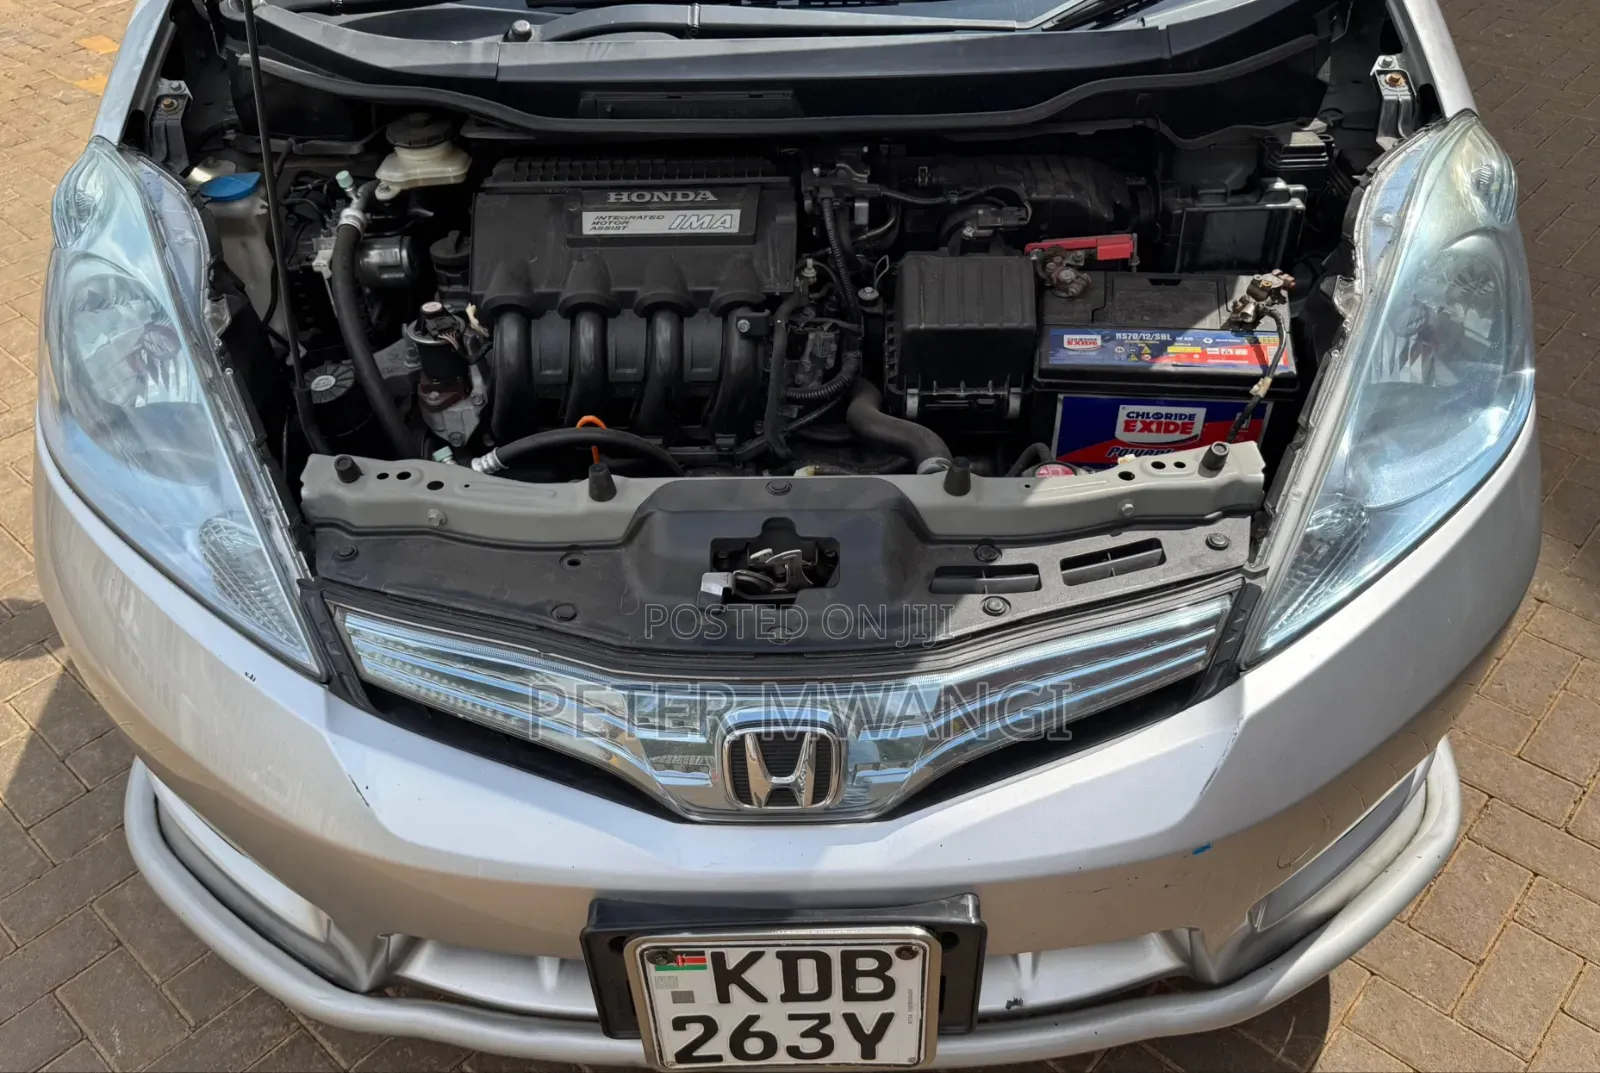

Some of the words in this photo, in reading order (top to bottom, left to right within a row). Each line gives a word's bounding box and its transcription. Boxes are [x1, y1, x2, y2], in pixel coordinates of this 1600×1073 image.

[606, 190, 718, 203] HONDA
[668, 213, 733, 231] IMA
[1125, 410, 1197, 421] CHLORIDE
[1123, 419, 1196, 435] EXIDE
[710, 949, 897, 1004] KDB
[671, 1011, 896, 1064] 263Y
